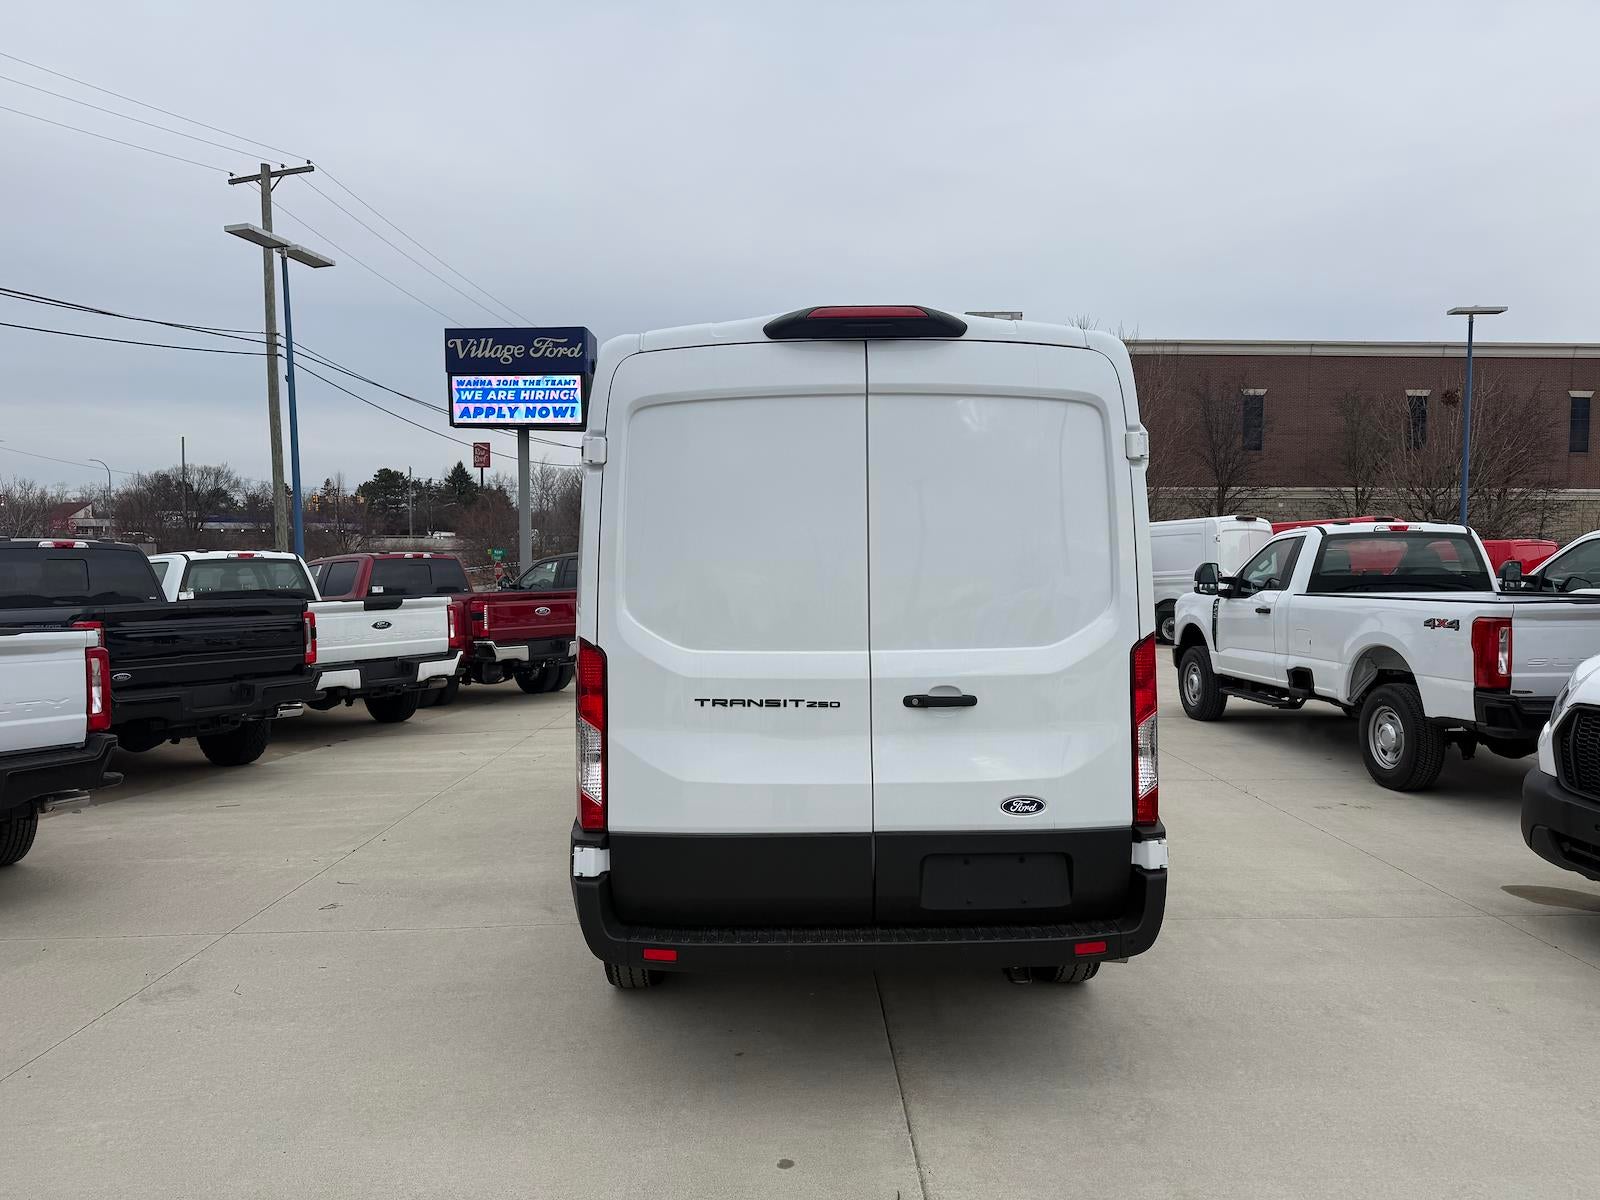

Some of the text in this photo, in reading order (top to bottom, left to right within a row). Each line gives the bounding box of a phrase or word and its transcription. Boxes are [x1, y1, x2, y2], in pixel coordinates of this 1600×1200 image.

[447, 337, 583, 365] Village Ford
[456, 379, 577, 387] WANNA JOIN THE TEAM?
[460, 390, 575, 400] WE ARE HIRING!
[458, 406, 576, 419] APPLY NOW!
[694, 698, 805, 708] TRANSIT
[1010, 800, 1038, 812] Ford
